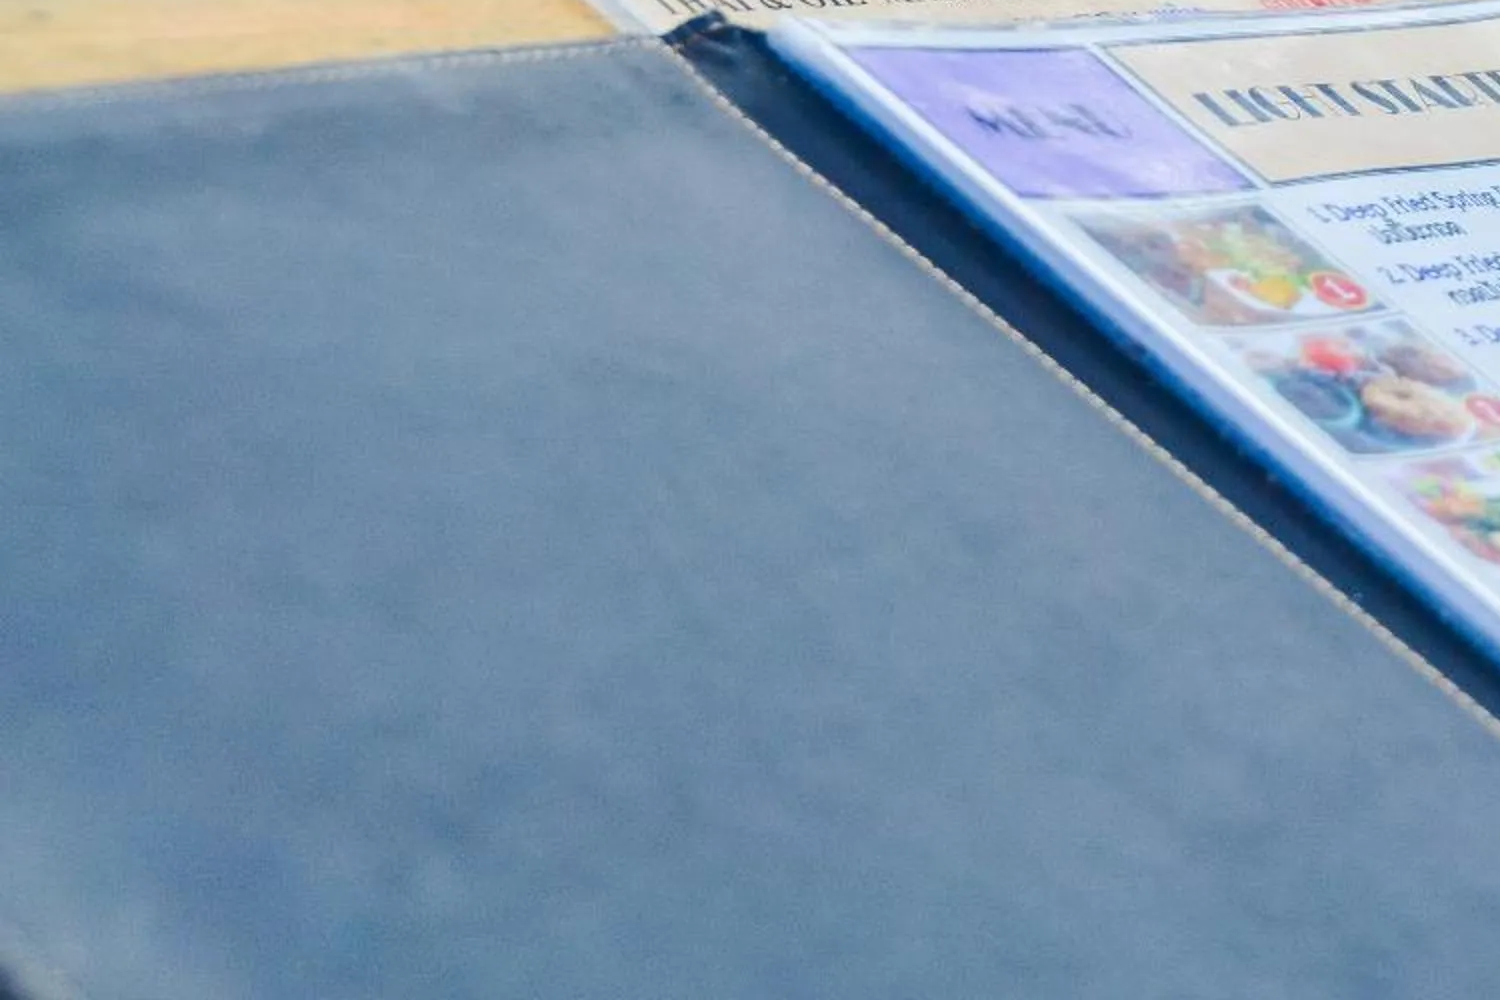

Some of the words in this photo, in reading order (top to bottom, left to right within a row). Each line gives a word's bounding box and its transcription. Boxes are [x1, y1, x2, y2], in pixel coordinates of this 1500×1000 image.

[1192, 81, 1361, 127] LIGHT
[1325, 199, 1388, 228] Deep
[1376, 195, 1432, 220] Fried
[1428, 188, 1497, 216] Spring
[1401, 258, 1462, 288] Deep
